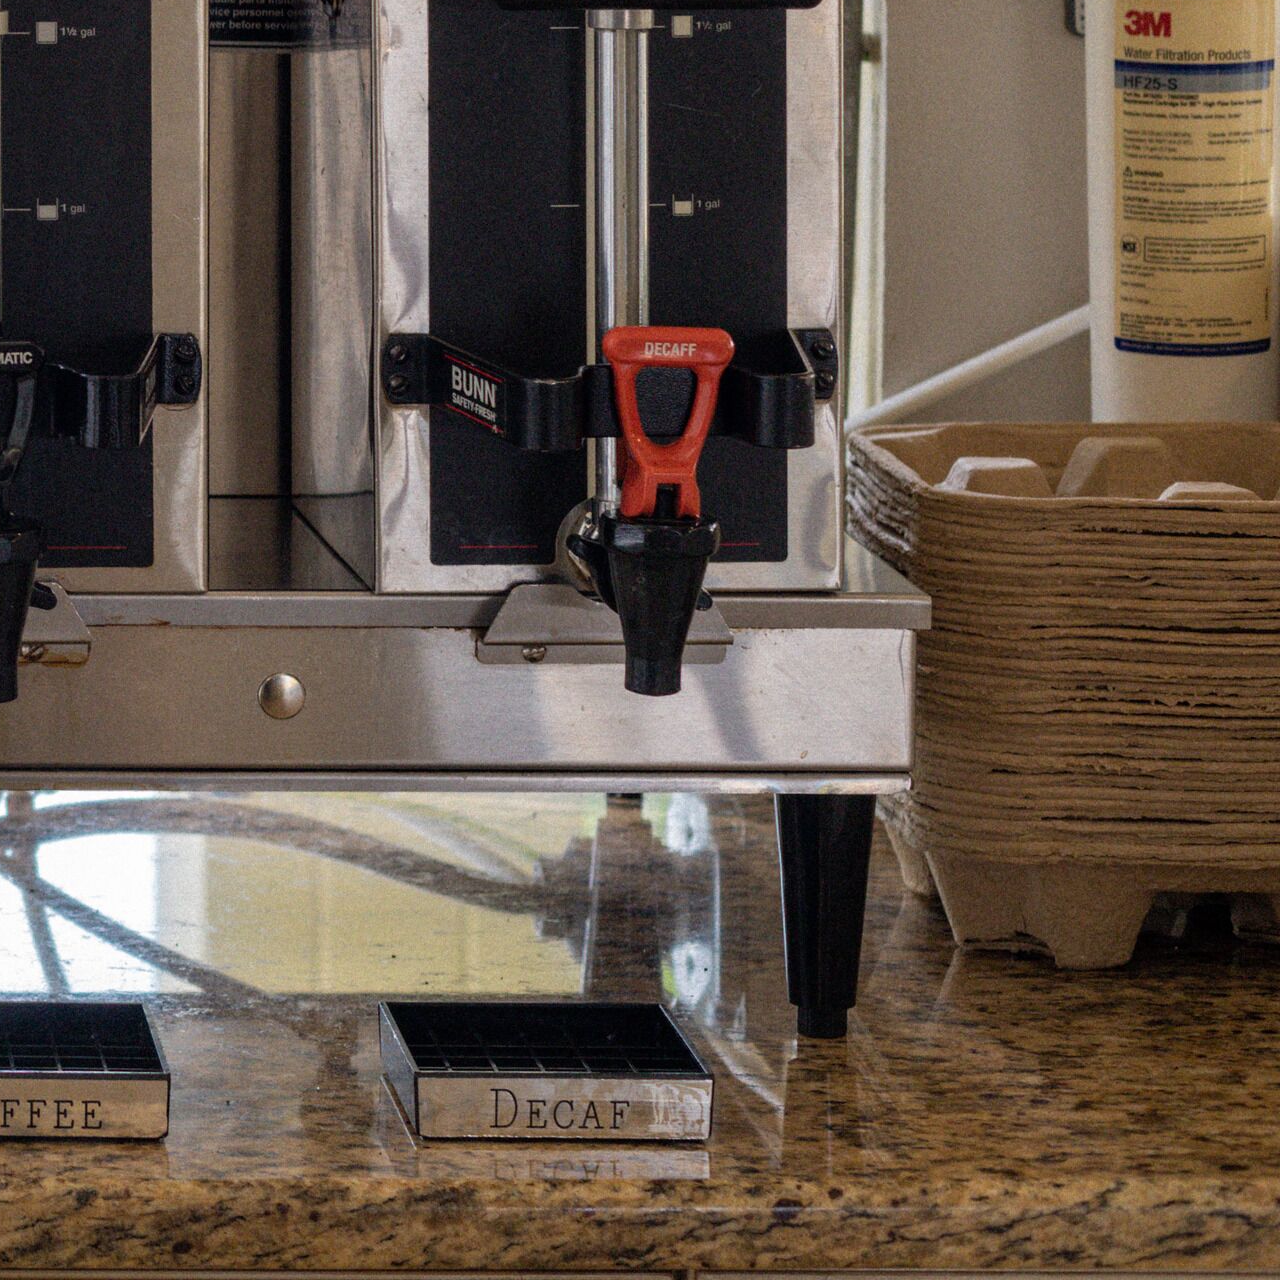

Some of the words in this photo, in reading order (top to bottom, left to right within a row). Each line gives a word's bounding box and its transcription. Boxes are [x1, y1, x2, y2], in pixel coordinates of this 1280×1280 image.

[232, 8, 284, 18] personnel
[229, 20, 262, 29] before
[715, 21, 732, 32] gal
[1124, 10, 1172, 37] 3M
[80, 26, 96, 38] gal
[1123, 47, 1152, 59] Water
[1155, 49, 1204, 61] Filtration
[1208, 49, 1252, 60] Products
[1123, 75, 1178, 91] HF25-S
[70, 203, 86, 214] gal
[705, 199, 720, 210] gal
[644, 341, 696, 357] DECAFF
